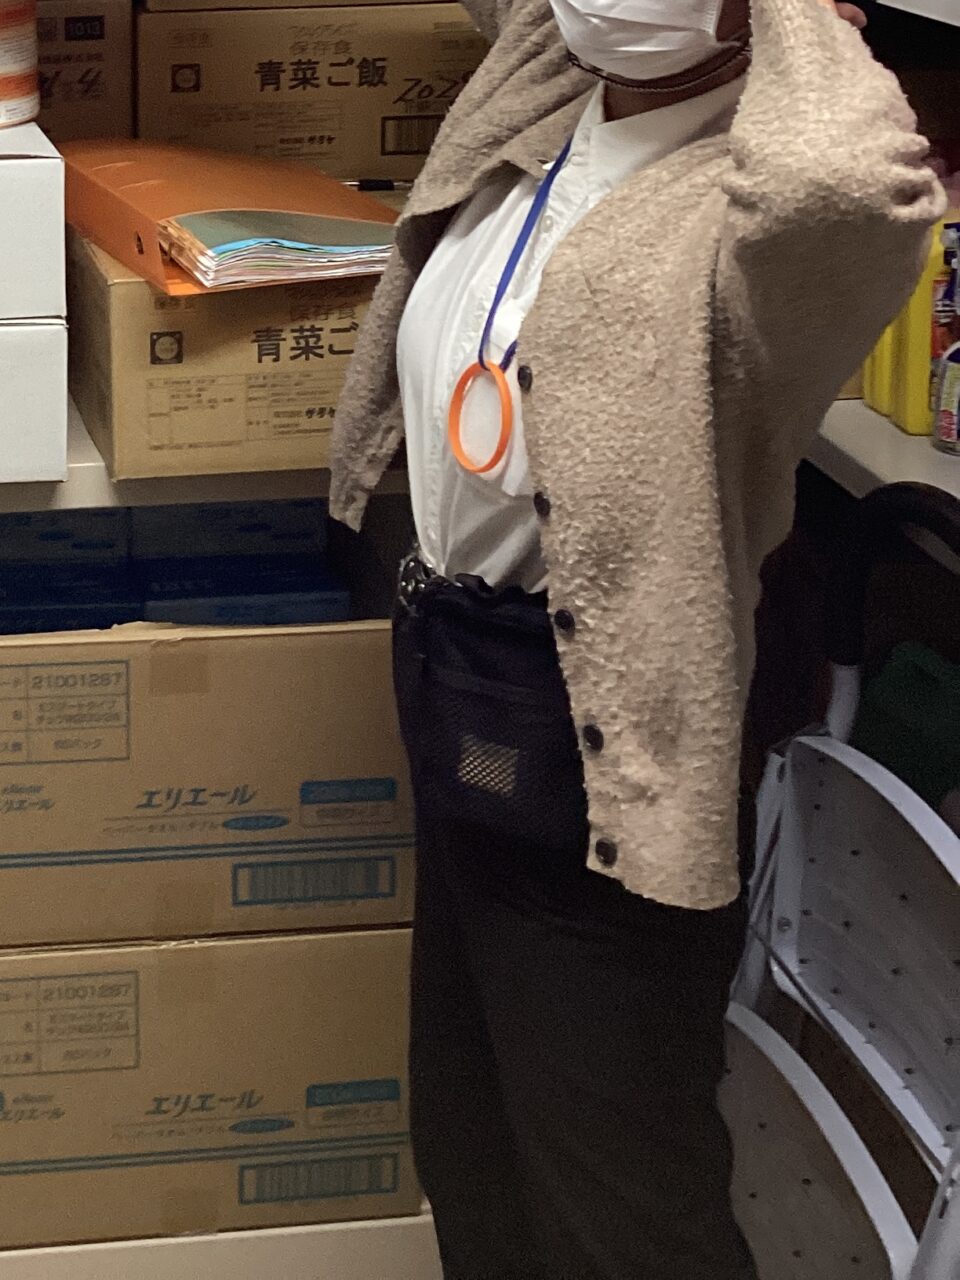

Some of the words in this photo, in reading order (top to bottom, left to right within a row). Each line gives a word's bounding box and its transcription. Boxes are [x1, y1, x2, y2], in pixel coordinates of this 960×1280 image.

[254, 57, 389, 93] 青菜ご飯
[393, 72, 470, 105] 202
[251, 321, 360, 364] 青菜ご
[135, 784, 258, 812] エリエール
[145, 1089, 265, 1117] エリエール
